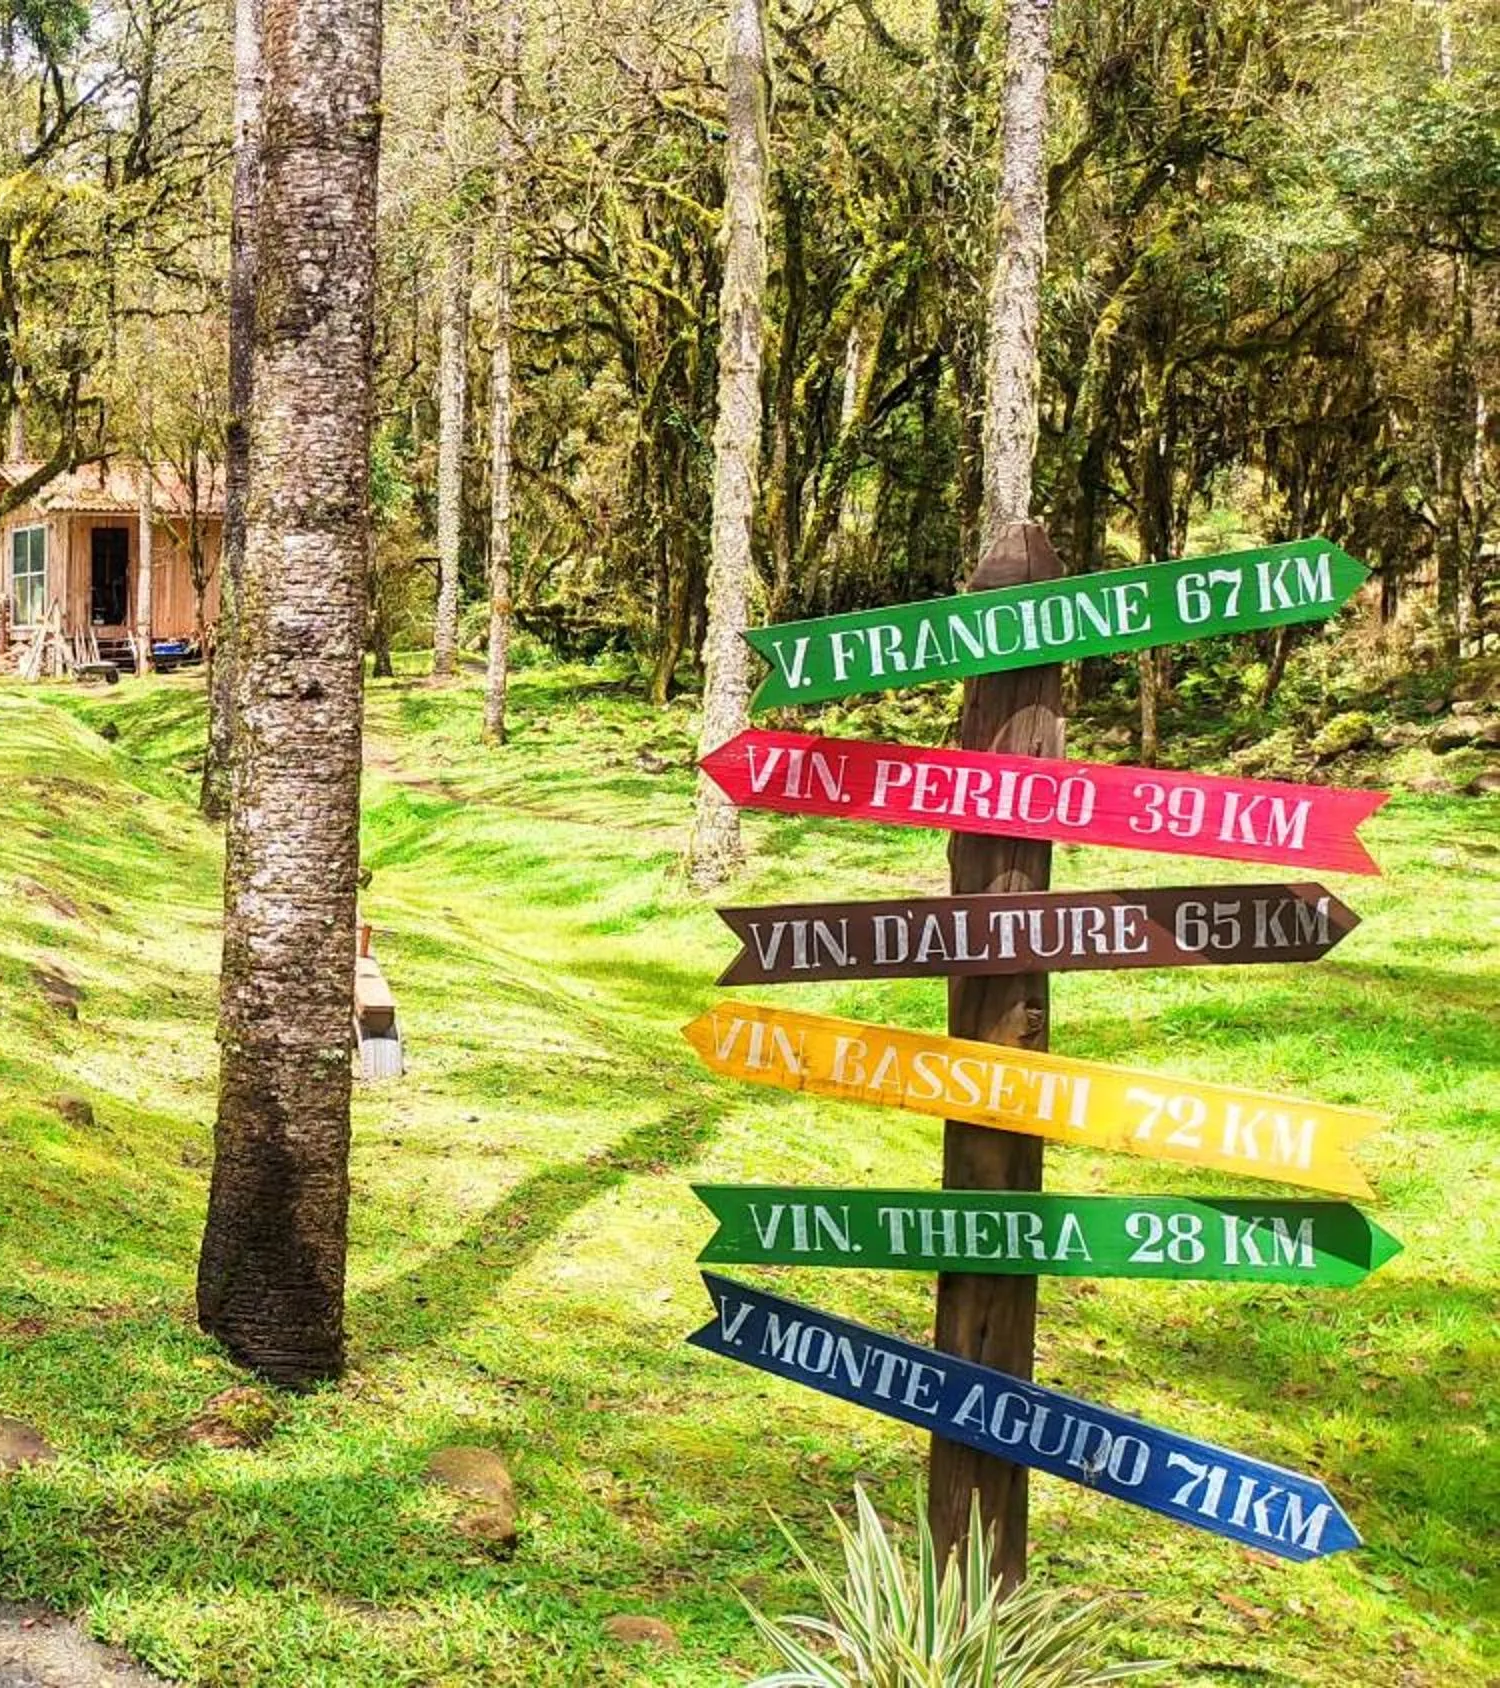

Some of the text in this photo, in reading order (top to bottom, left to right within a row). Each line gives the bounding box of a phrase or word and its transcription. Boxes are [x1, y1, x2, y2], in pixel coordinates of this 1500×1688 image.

[773, 553, 1336, 689] V. FRANCIONE 67 KM
[745, 745, 1311, 850] VIN. PERICÓ 39 KM
[749, 897, 1333, 970] VIN. D'ALTURE 65 KM
[828, 1037, 1092, 1131] BASSETI
[1125, 1087, 1206, 1149] 72
[1220, 1102, 1318, 1169] KM
[749, 1204, 1316, 1269] VIN. THERA 28 KM
[719, 1296, 1331, 1555] V. MONTE AGUDO 71 KM
